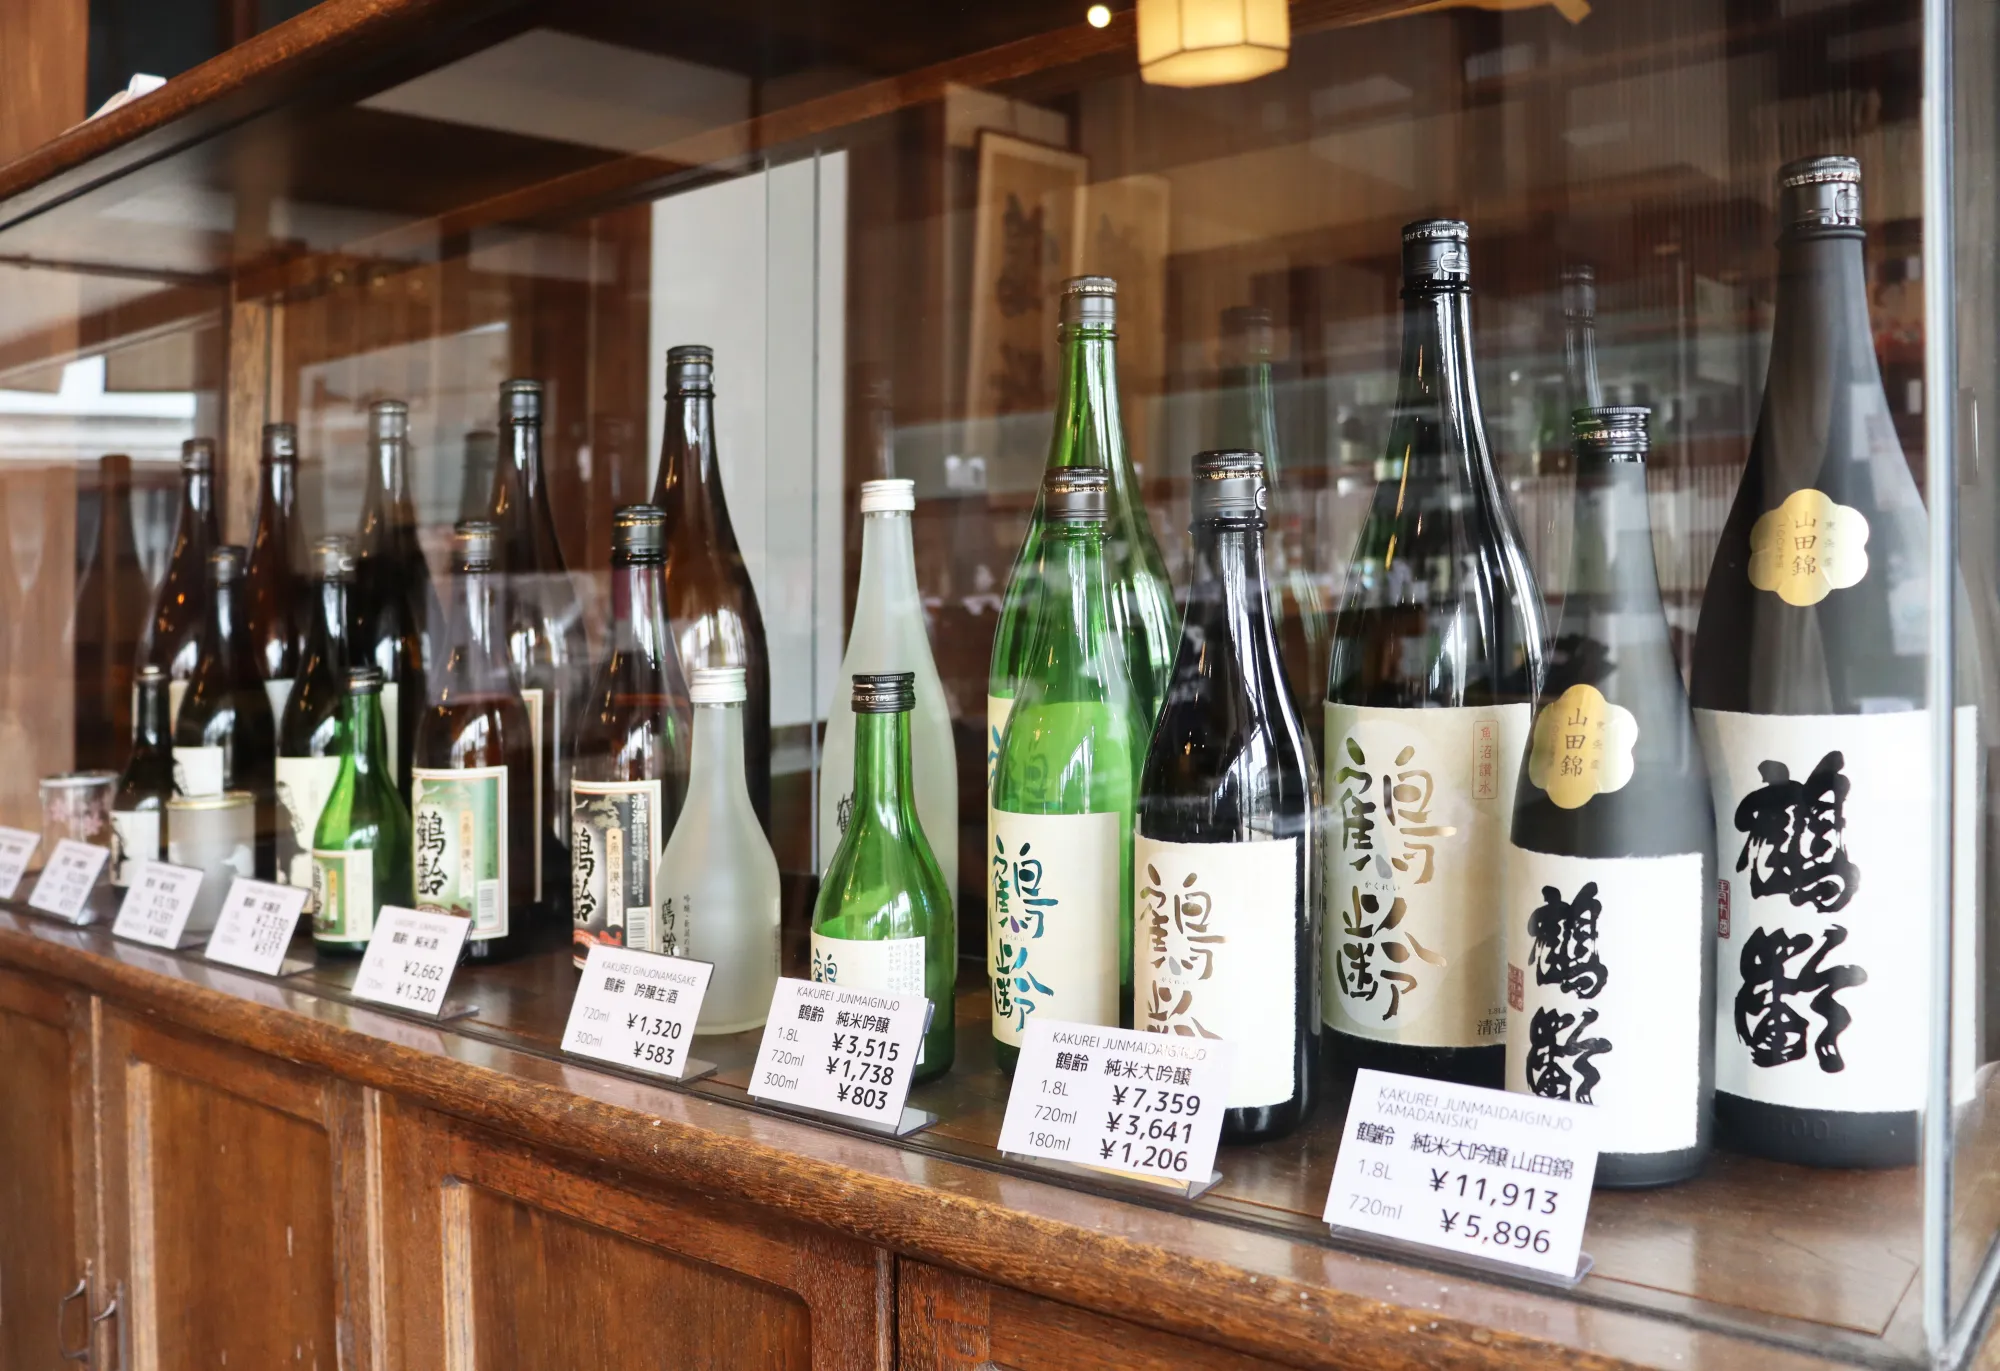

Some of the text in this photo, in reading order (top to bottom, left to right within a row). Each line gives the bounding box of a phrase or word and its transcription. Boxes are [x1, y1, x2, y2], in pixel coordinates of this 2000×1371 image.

[1792, 511, 1817, 576] 山田錦
[1560, 707, 1588, 777] 山田錦
[403, 959, 444, 982] ¥2,662
[602, 961, 697, 987] KAKUREI GINJONAMASAKE
[395, 980, 436, 1003] ¥1,320
[634, 983, 679, 1005] 吟醸生酒
[796, 986, 900, 1012] KAKUREI JUNMAIGINJO
[626, 1012, 682, 1040] ¥1,320
[797, 1003, 891, 1035] 鶴齢 純米吟醸
[632, 1040, 675, 1066] ¥583
[776, 1026, 900, 1062] 1.8L ¥3,515
[1052, 1031, 1101, 1049] KAKUREI
[771, 1049, 895, 1086] 720ml ¥1,738
[1055, 1051, 1193, 1087] 鶴齢 純米大吟醸
[763, 1071, 889, 1111] 300ml ¥803
[1040, 1079, 1201, 1117] 1.8L ¥7,359
[1378, 1085, 1573, 1133] KAKUREI JUNMAIDAIGINJO
[1034, 1104, 1193, 1145] 720ml ¥3,641
[1356, 1121, 1396, 1147] 鶴齢
[1376, 1101, 1479, 1131] YAMADANISIKI
[1027, 1131, 1189, 1173] 180ml ¥1,206
[1357, 1158, 1559, 1215] 1.8L ¥11,913
[1348, 1193, 1551, 1253] 720ml ¥5,896
